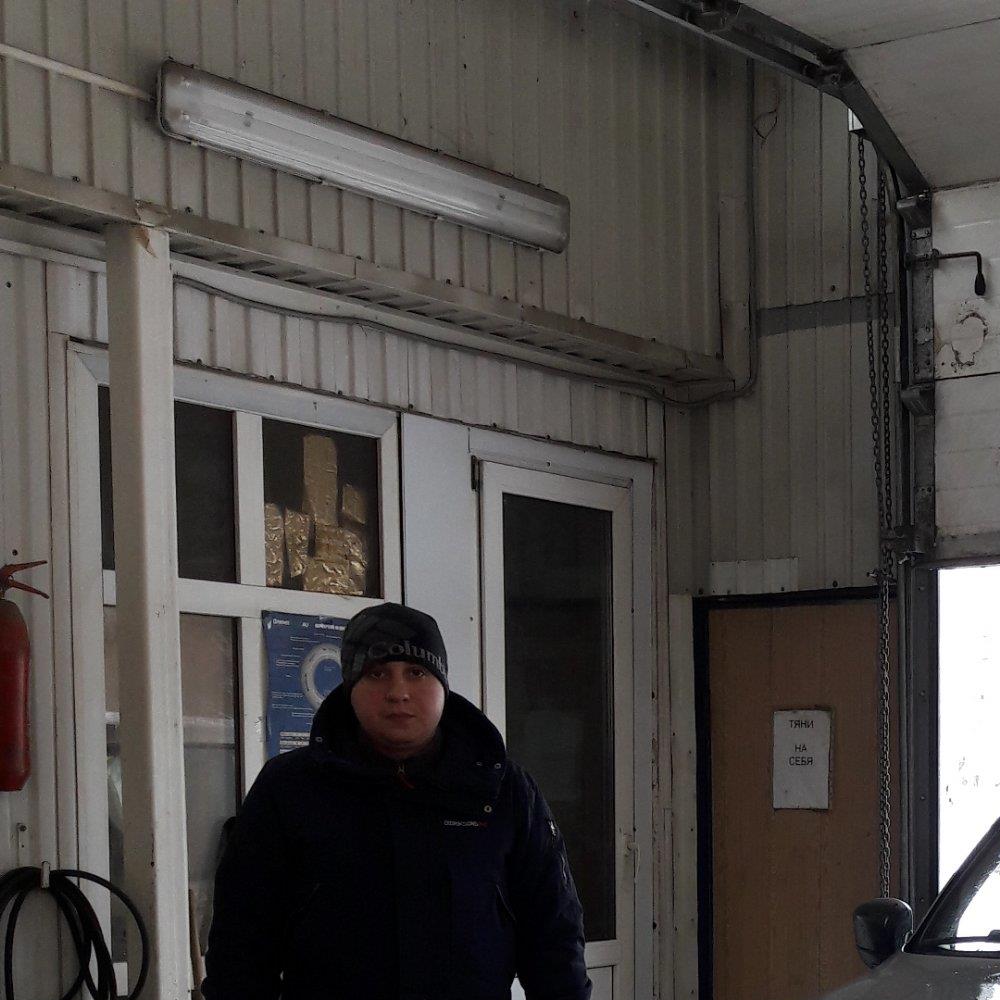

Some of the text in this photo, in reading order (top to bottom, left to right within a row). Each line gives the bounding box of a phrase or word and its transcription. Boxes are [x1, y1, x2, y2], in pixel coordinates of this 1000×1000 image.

[788, 719, 814, 729] ТЯНИ
[794, 744, 807, 753] НА
[788, 756, 814, 767] СЕБЯ
